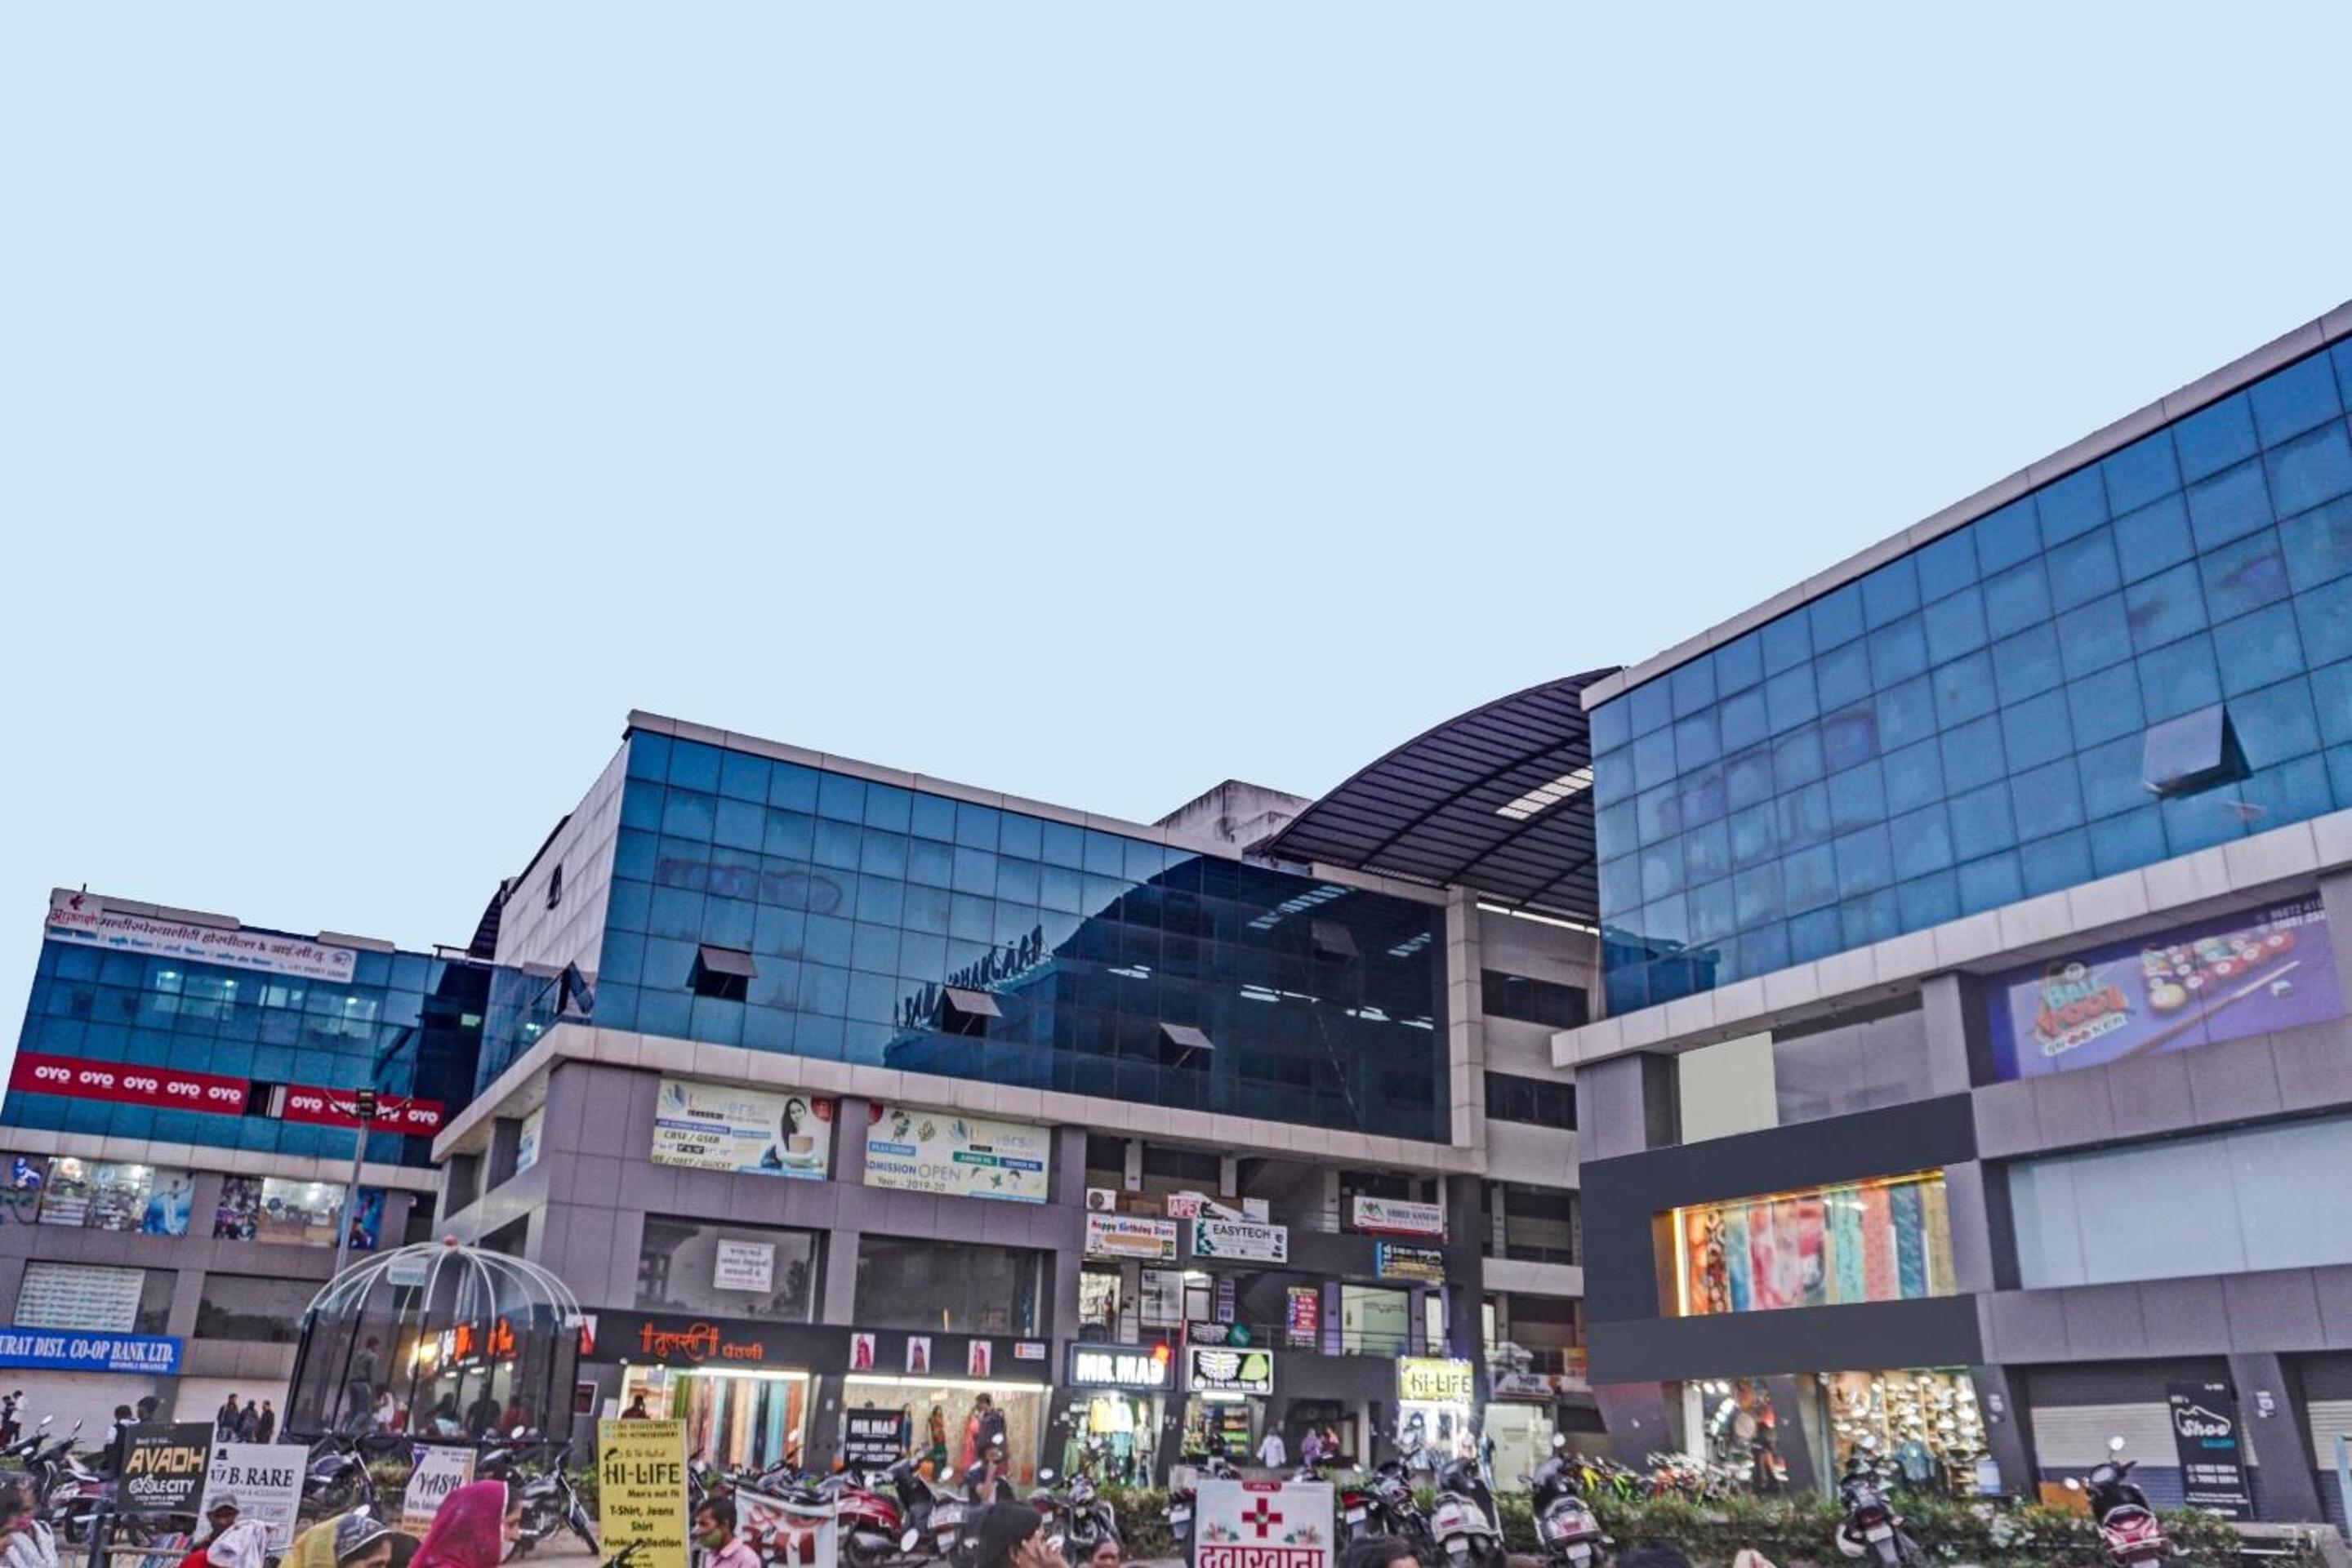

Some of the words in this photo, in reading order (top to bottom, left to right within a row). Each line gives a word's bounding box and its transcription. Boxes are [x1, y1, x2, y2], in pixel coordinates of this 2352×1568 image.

[34, 1065, 71, 1081] OYO
[79, 1070, 115, 1087] OYO
[123, 1076, 158, 1092] OYO
[167, 1080, 201, 1097] OYO
[208, 1085, 242, 1102] OYO
[291, 1095, 323, 1111] OYO
[408, 1108, 439, 1124] OYO
[918, 1164, 960, 1181] OPEN
[1091, 1219, 1117, 1233] Happy
[1118, 1221, 1152, 1236] Birthday
[1213, 1224, 1272, 1240] EASYTECH
[34, 1337, 67, 1359] DIST.
[69, 1339, 111, 1361] CO-OP
[110, 1341, 149, 1362] BANK
[148, 1343, 174, 1363] LTD.
[125, 1446, 207, 1474] AVADH
[604, 1463, 681, 1485] HI-LIFE
[627, 1489, 652, 1498] Men's
[654, 1490, 668, 1498] out
[609, 1504, 643, 1517] T-Shirt,
[646, 1505, 675, 1516] Jeans
[630, 1521, 653, 1531] Shirt
